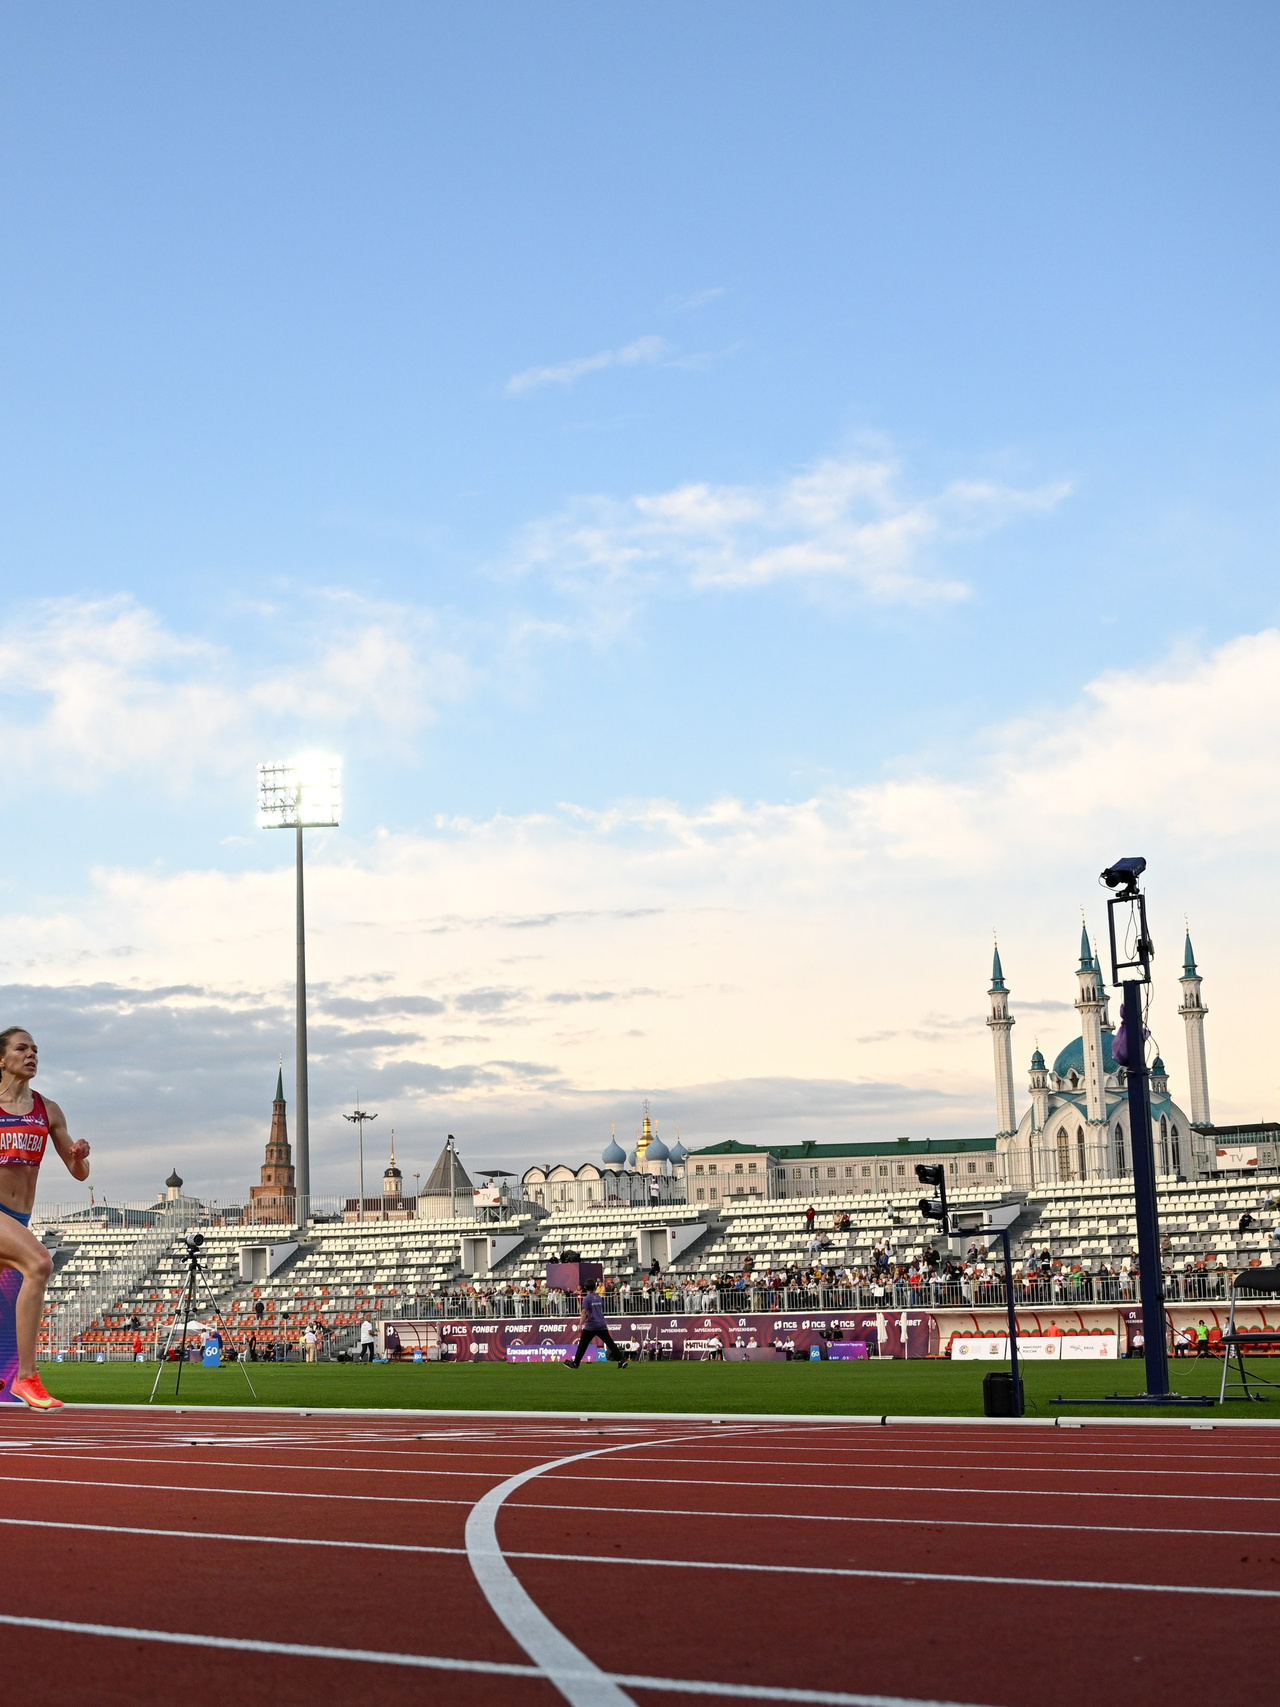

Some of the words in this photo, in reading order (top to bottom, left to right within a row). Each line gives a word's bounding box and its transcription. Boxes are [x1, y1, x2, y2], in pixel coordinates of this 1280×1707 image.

[1230, 1154, 1243, 1162] TV
[505, 1325, 532, 1333] FONBET
[206, 1346, 218, 1357] 60
